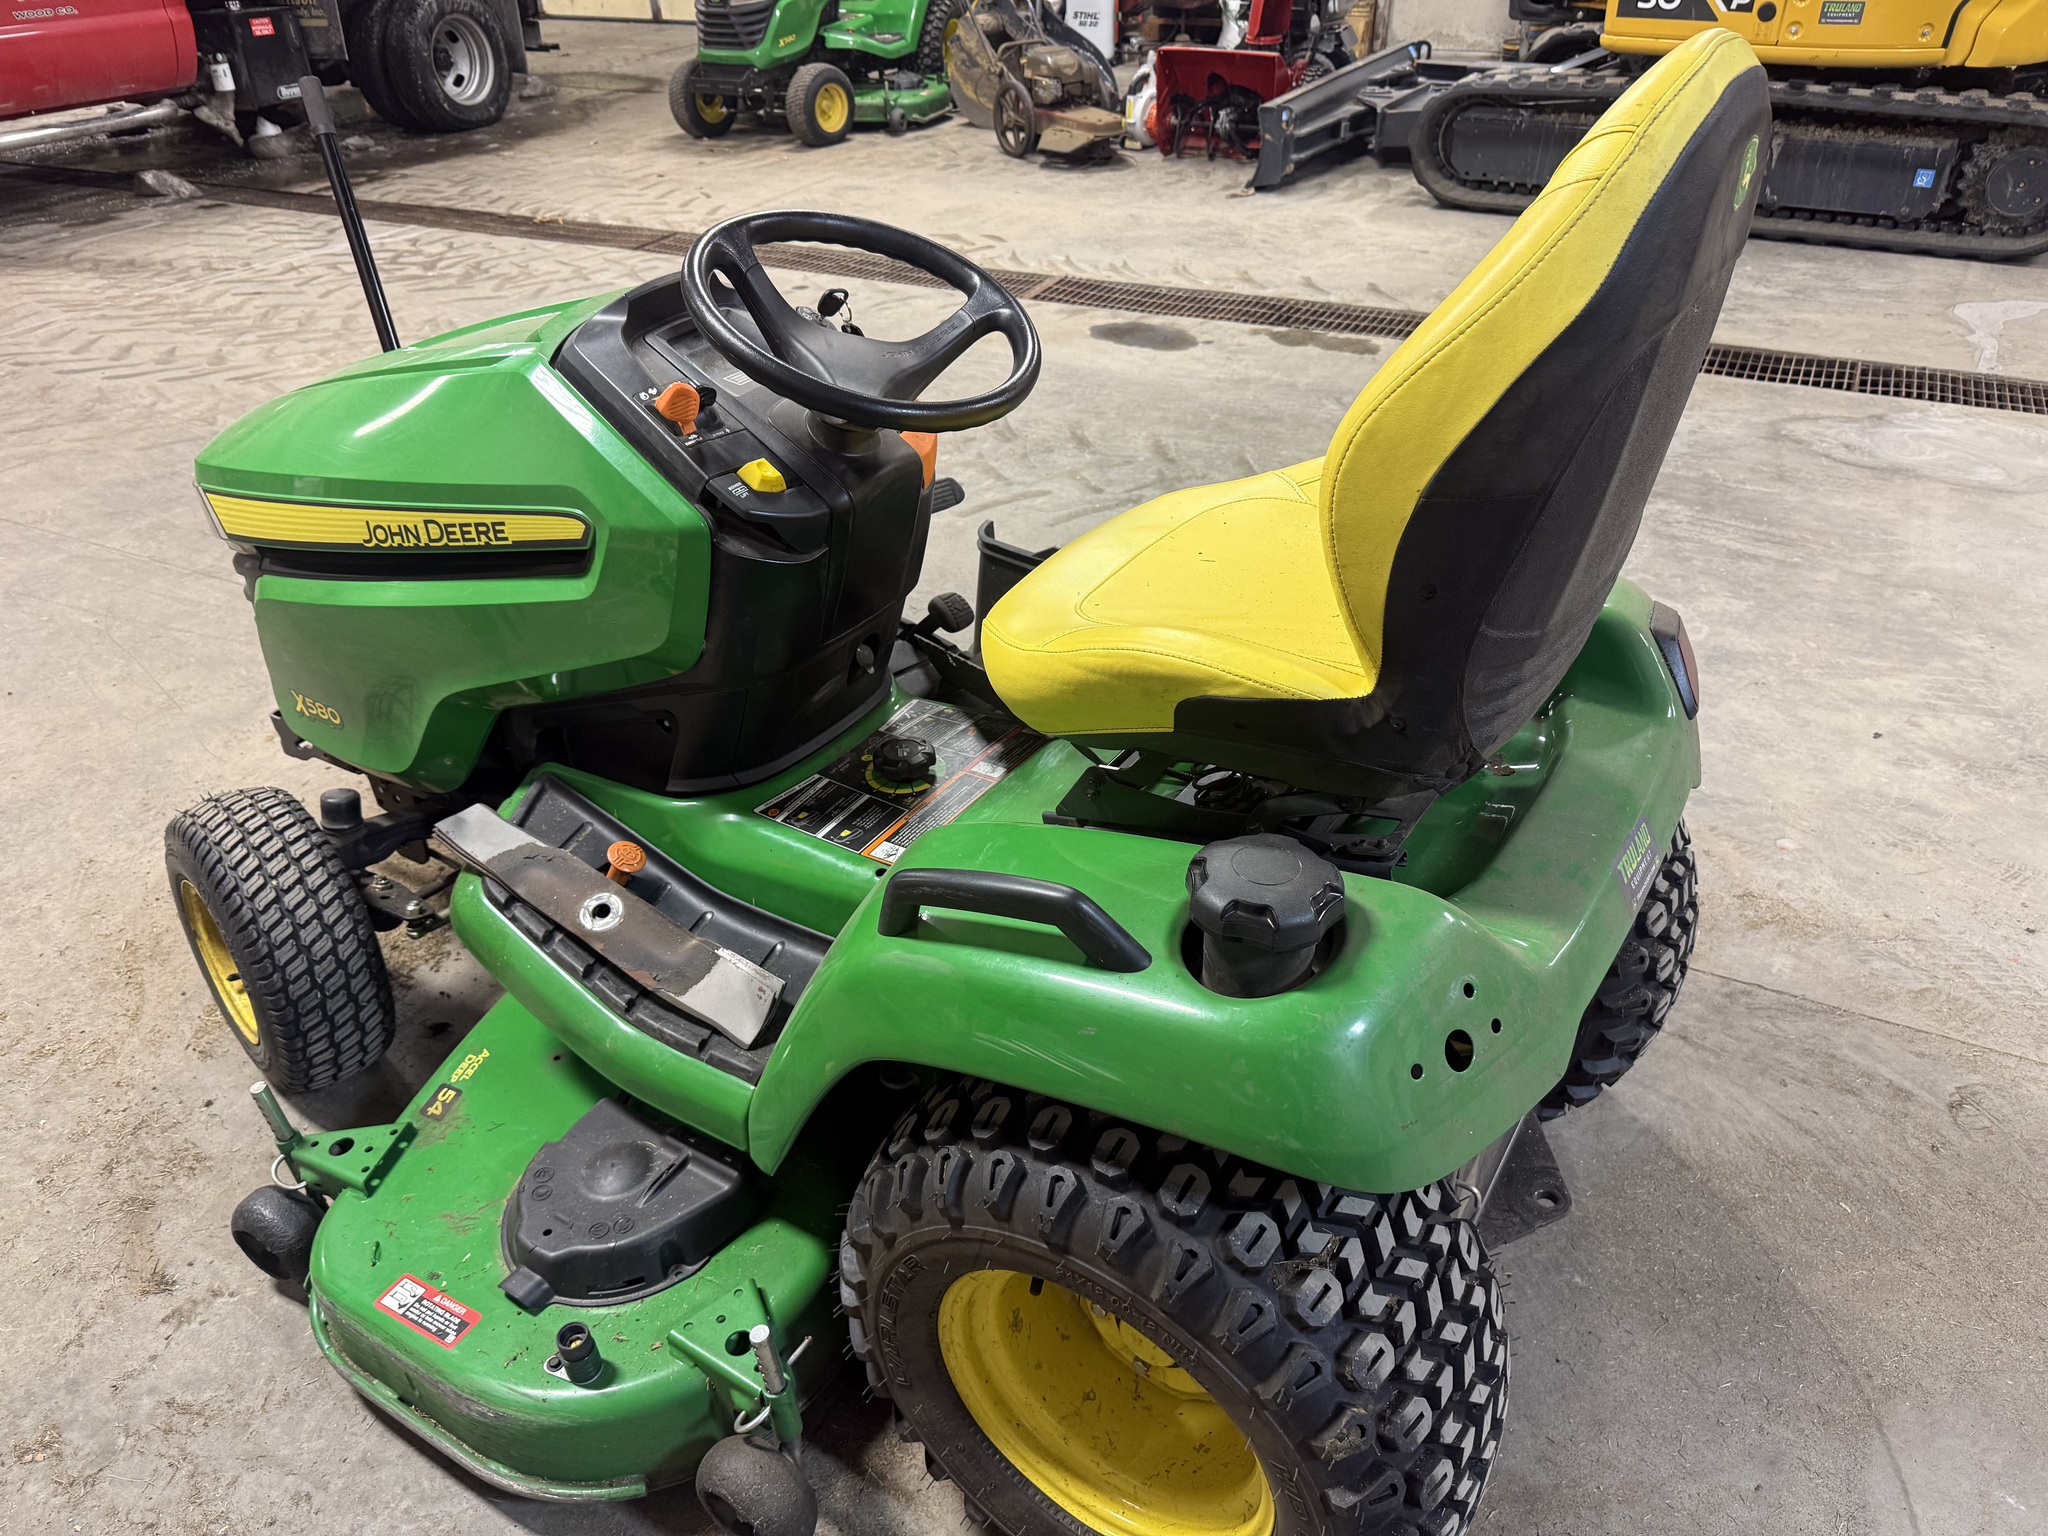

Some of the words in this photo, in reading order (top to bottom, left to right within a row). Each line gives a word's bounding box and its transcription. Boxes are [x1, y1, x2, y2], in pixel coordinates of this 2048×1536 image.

[12, 8, 54, 20] WOOD
[56, 6, 79, 16] CO.
[1072, 11, 1100, 20] STIHL
[1823, 3, 1863, 13] TRULAND
[881, 349, 914, 359] JOHN
[917, 322, 959, 352] DEERE
[363, 520, 423, 546] JOHN
[423, 519, 511, 545] DEERE
[290, 689, 342, 726] X580
[1616, 822, 1651, 885] TRULAND
[1630, 849, 1653, 889] EQUIPMENT
[450, 1053, 477, 1083] DEEP
[459, 1047, 490, 1082] ACCEL
[426, 1087, 457, 1116] 54
[421, 1299, 446, 1316] ROTATING
[443, 1311, 461, 1325] BLADE
[440, 1297, 467, 1315] DANGER
[879, 1253, 929, 1386] CARLSTAR
